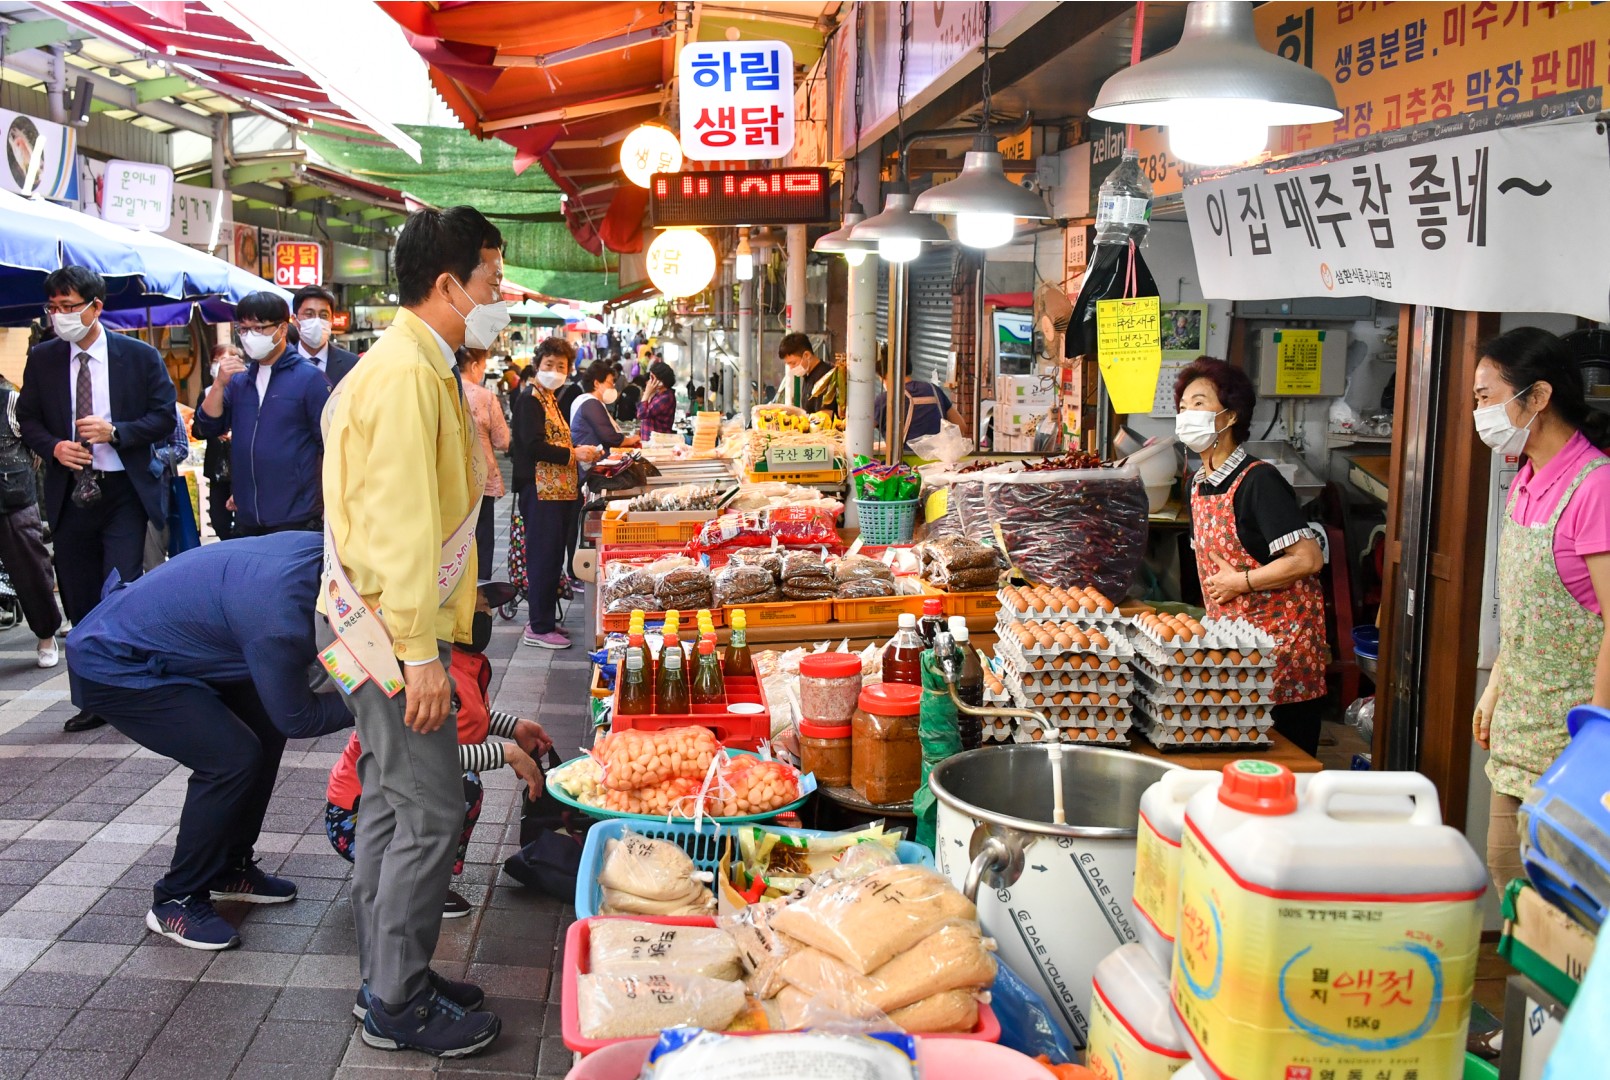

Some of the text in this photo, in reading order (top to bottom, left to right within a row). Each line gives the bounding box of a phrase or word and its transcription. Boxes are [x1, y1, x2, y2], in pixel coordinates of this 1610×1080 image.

[691, 49, 780, 92] 하림
[1467, 60, 1524, 112] 막장
[1530, 38, 1596, 100] 판매
[693, 105, 784, 147] 생닭
[111, 195, 161, 217] 과일가게
[1206, 188, 1233, 257] 이
[1236, 183, 1272, 256] 집
[278, 244, 317, 266] 생닭
[773, 447, 826, 461] 국산 황기
[1088, 865, 1137, 944] DAE YOUNG
[1024, 924, 1047, 956] DAE
[1043, 957, 1075, 1005] YOUNG
[1332, 968, 1415, 1007] 액젓
[1346, 1016, 1380, 1031] 15Kg
